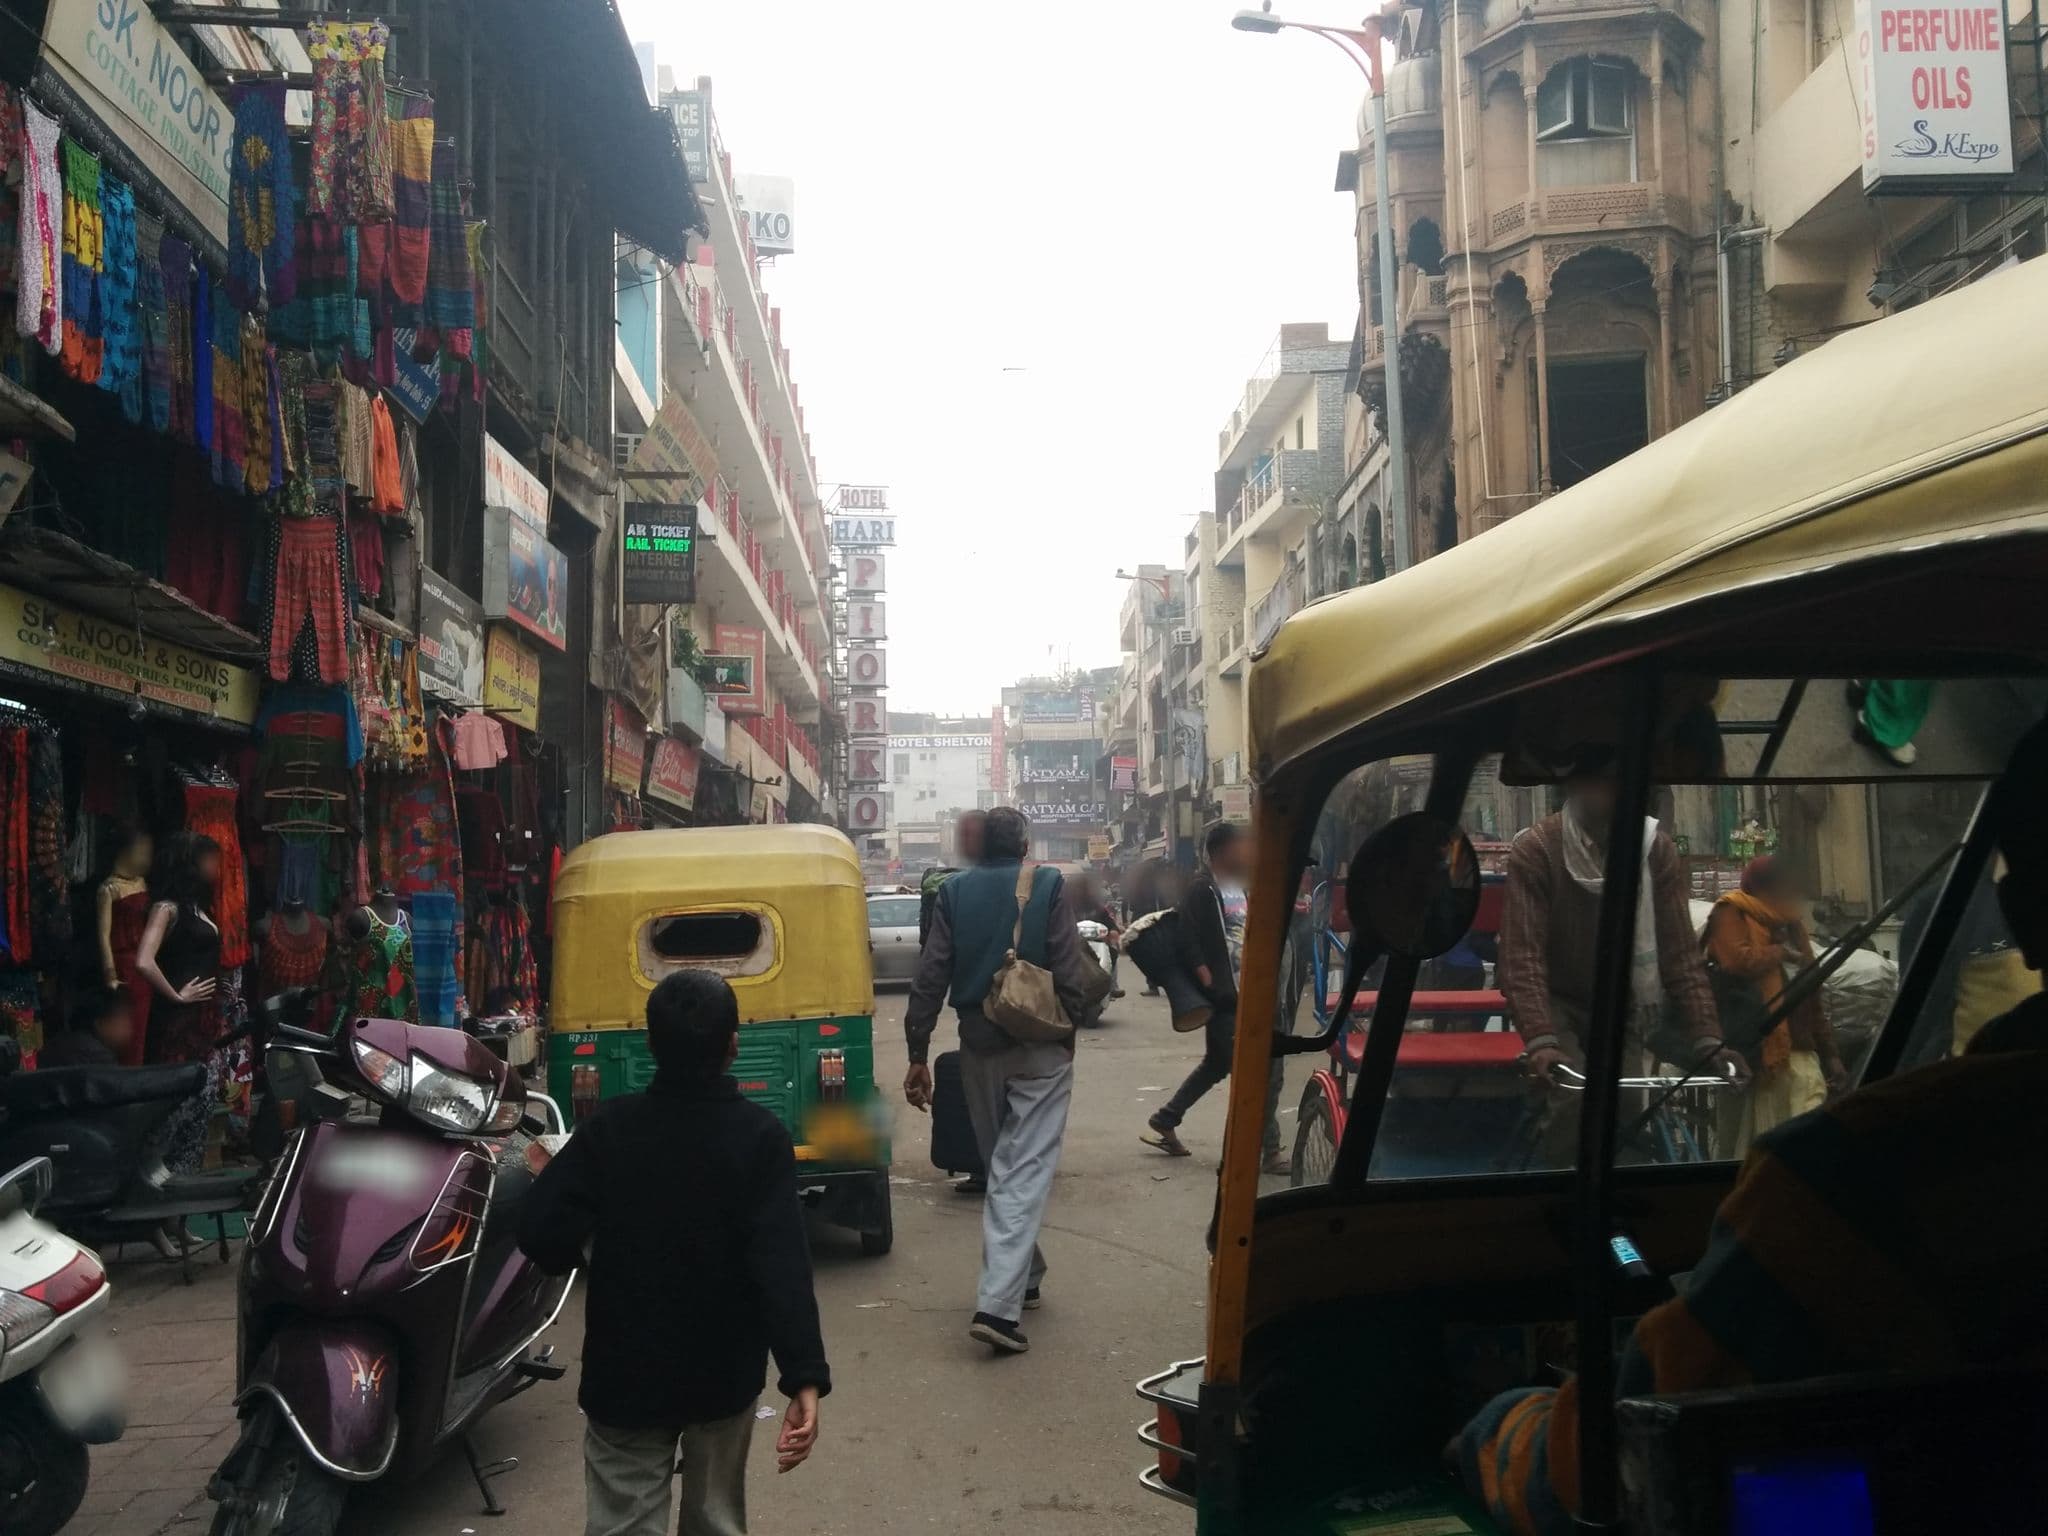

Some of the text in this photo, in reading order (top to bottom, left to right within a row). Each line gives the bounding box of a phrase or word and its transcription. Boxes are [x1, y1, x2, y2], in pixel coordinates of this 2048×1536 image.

[1880, 8, 2000, 52] PERFUME
[86, 29, 157, 127] COTTAGE
[1911, 66, 1972, 110] OILS
[149, 38, 220, 155] NOOR
[840, 487, 886, 508] HOTEL
[626, 523, 691, 538] AIR TICKET
[834, 519, 895, 543] HARI
[626, 537, 691, 552] RAIL TICKET
[626, 552, 689, 567] INTERNET
[17, 628, 89, 662] COAGE
[95, 654, 169, 685] INDUSTRIES
[77, 620, 148, 664] NOOR
[154, 648, 169, 671] &
[175, 654, 229, 687] SONS
[888, 735, 992, 748] HOTEL SHELTON
[1022, 768, 1075, 778] SATYAM
[1022, 803, 1076, 814] SATYAM
